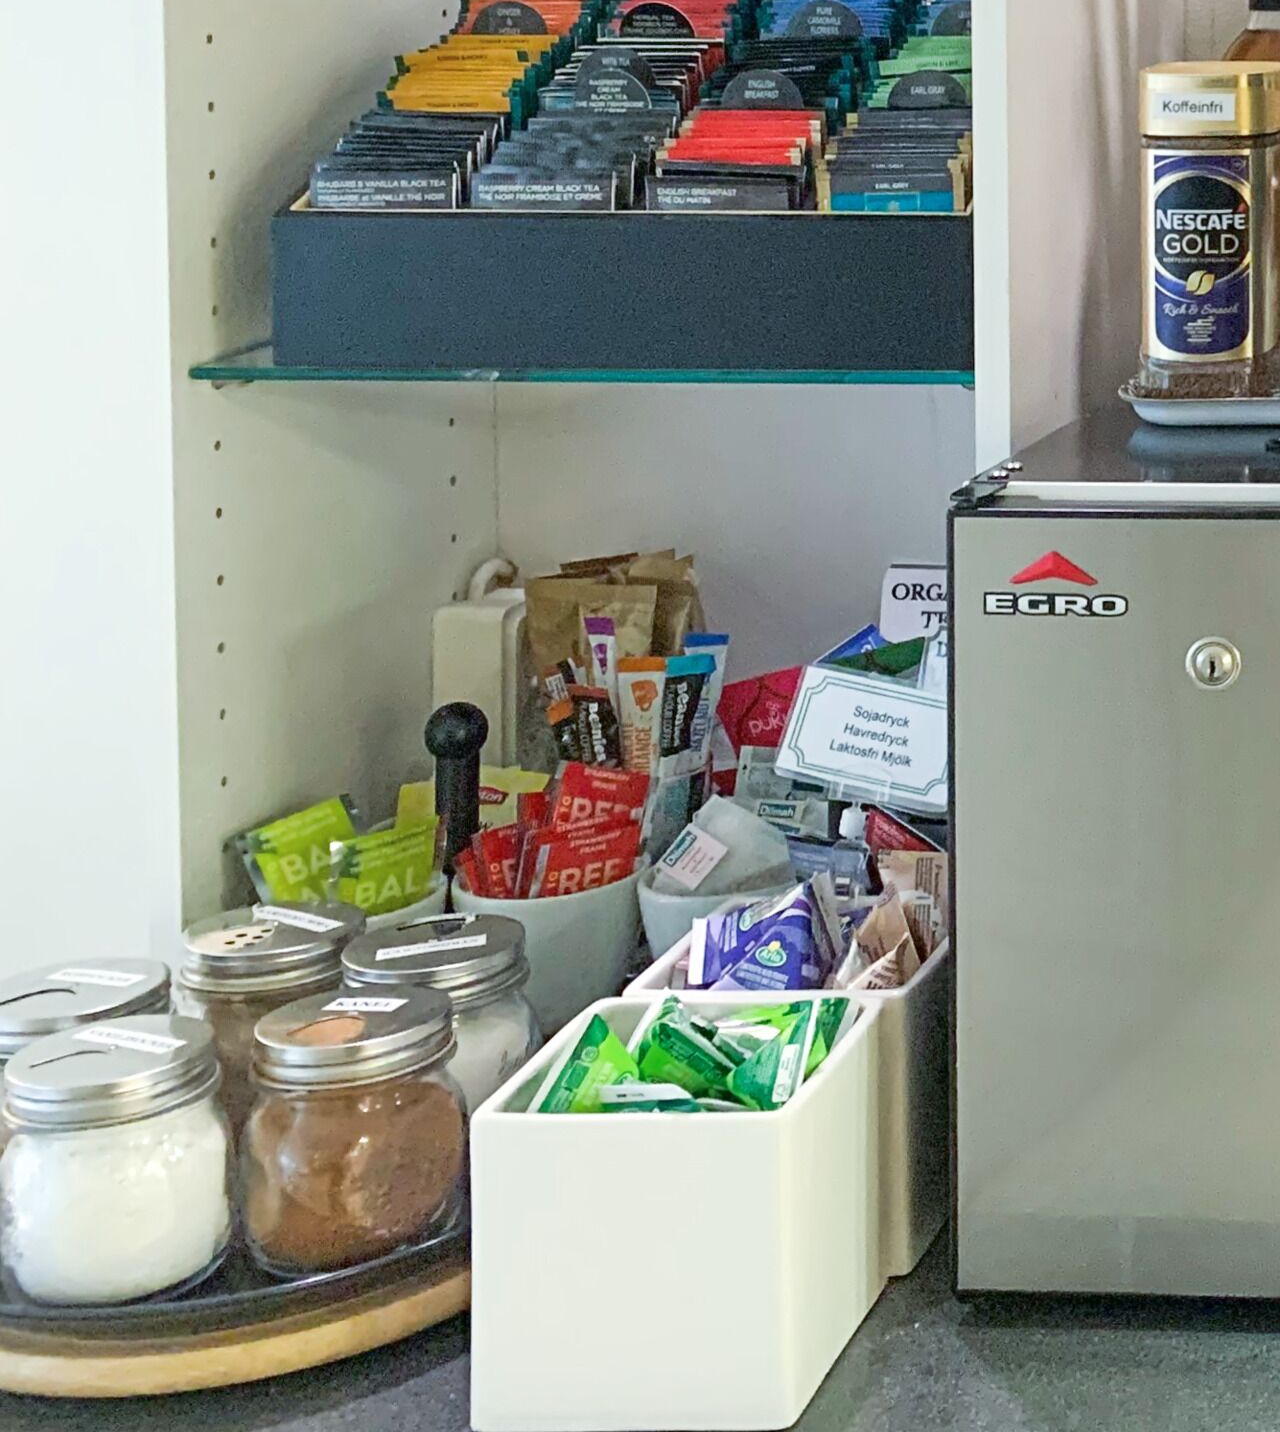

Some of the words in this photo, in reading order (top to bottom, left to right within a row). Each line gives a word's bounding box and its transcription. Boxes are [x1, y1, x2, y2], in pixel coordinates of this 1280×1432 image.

[910, 85, 928, 95] EARL
[1161, 99, 1224, 114] Koffeinfri
[429, 179, 447, 187] TEA
[583, 184, 600, 192] TEA
[1162, 233, 1240, 255] GOLD
[1162, 303, 1188, 317] Rich
[1188, 304, 1199, 316] &
[983, 591, 1129, 618] EGRO
[853, 704, 911, 729] Sojadryck
[588, 702, 607, 762] Beanies
[842, 721, 910, 748] Havredryck
[828, 738, 880, 761] Laktosfri
[759, 803, 795, 818] Dilmah
[664, 832, 696, 866] Dilmah
